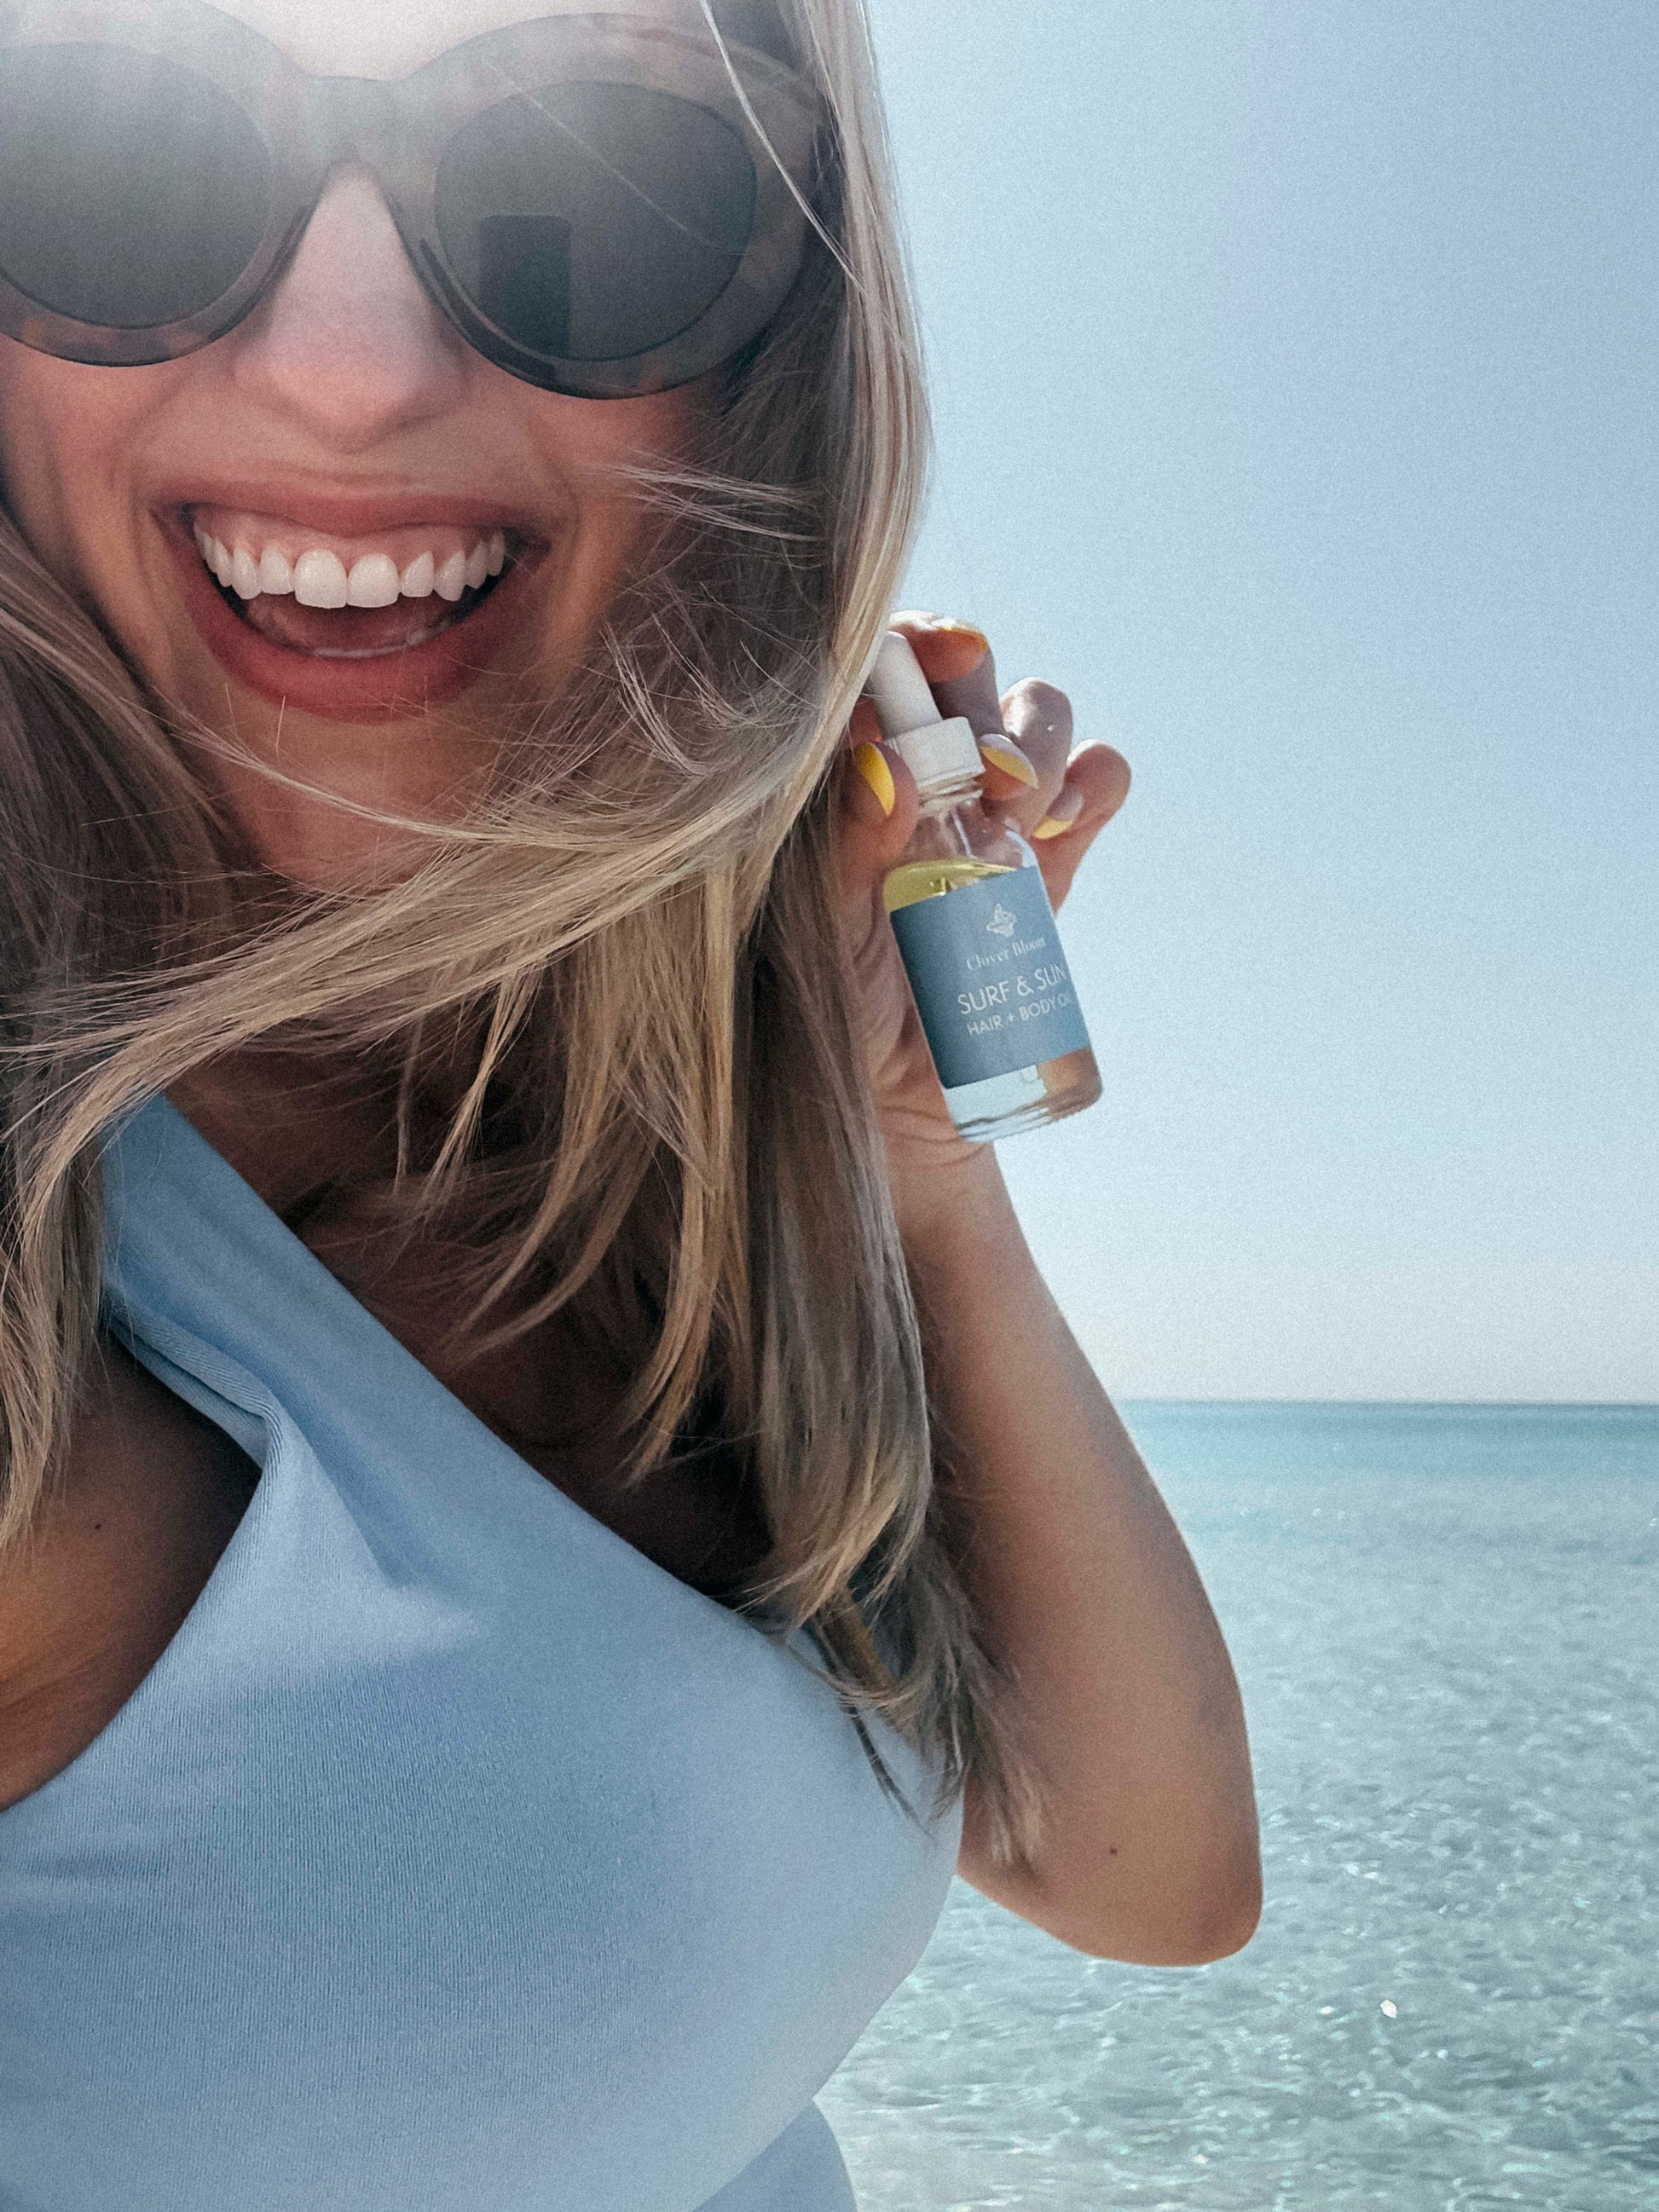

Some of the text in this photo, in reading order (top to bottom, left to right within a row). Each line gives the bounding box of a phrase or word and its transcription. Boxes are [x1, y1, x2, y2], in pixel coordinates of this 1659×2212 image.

[957, 963, 1067, 1014] SURF & SUN
[968, 1014, 1003, 1037] HAIR
[1007, 1013, 1015, 1023] +
[1019, 996, 1056, 1021] BODY
